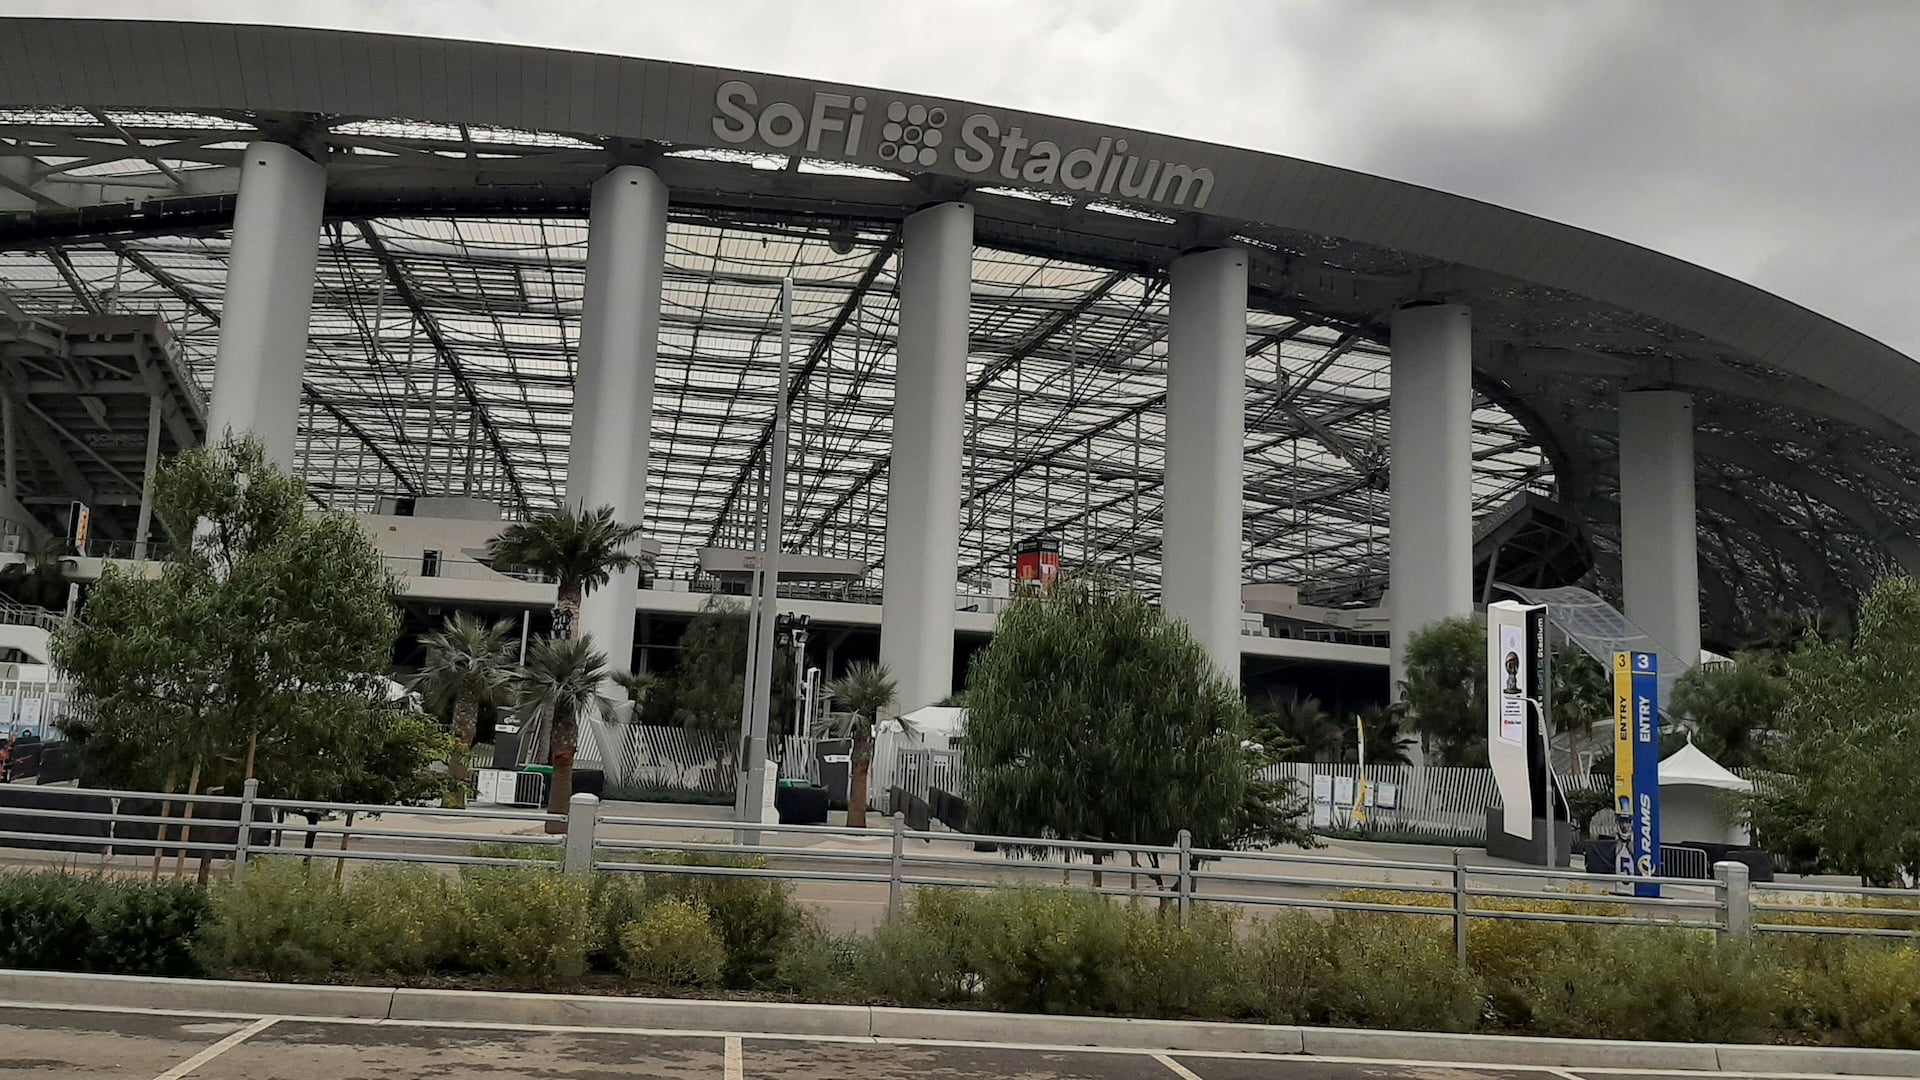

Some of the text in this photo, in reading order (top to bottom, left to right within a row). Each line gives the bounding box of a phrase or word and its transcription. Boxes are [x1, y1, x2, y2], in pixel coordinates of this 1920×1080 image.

[711, 79, 1216, 209] SoFi Stadium
[1618, 654, 1626, 667] 3
[1638, 654, 1649, 669] 3
[1620, 696, 1628, 741] ENTRY
[1639, 696, 1651, 743] ENTRY
[1640, 793, 1651, 853] RAMS
